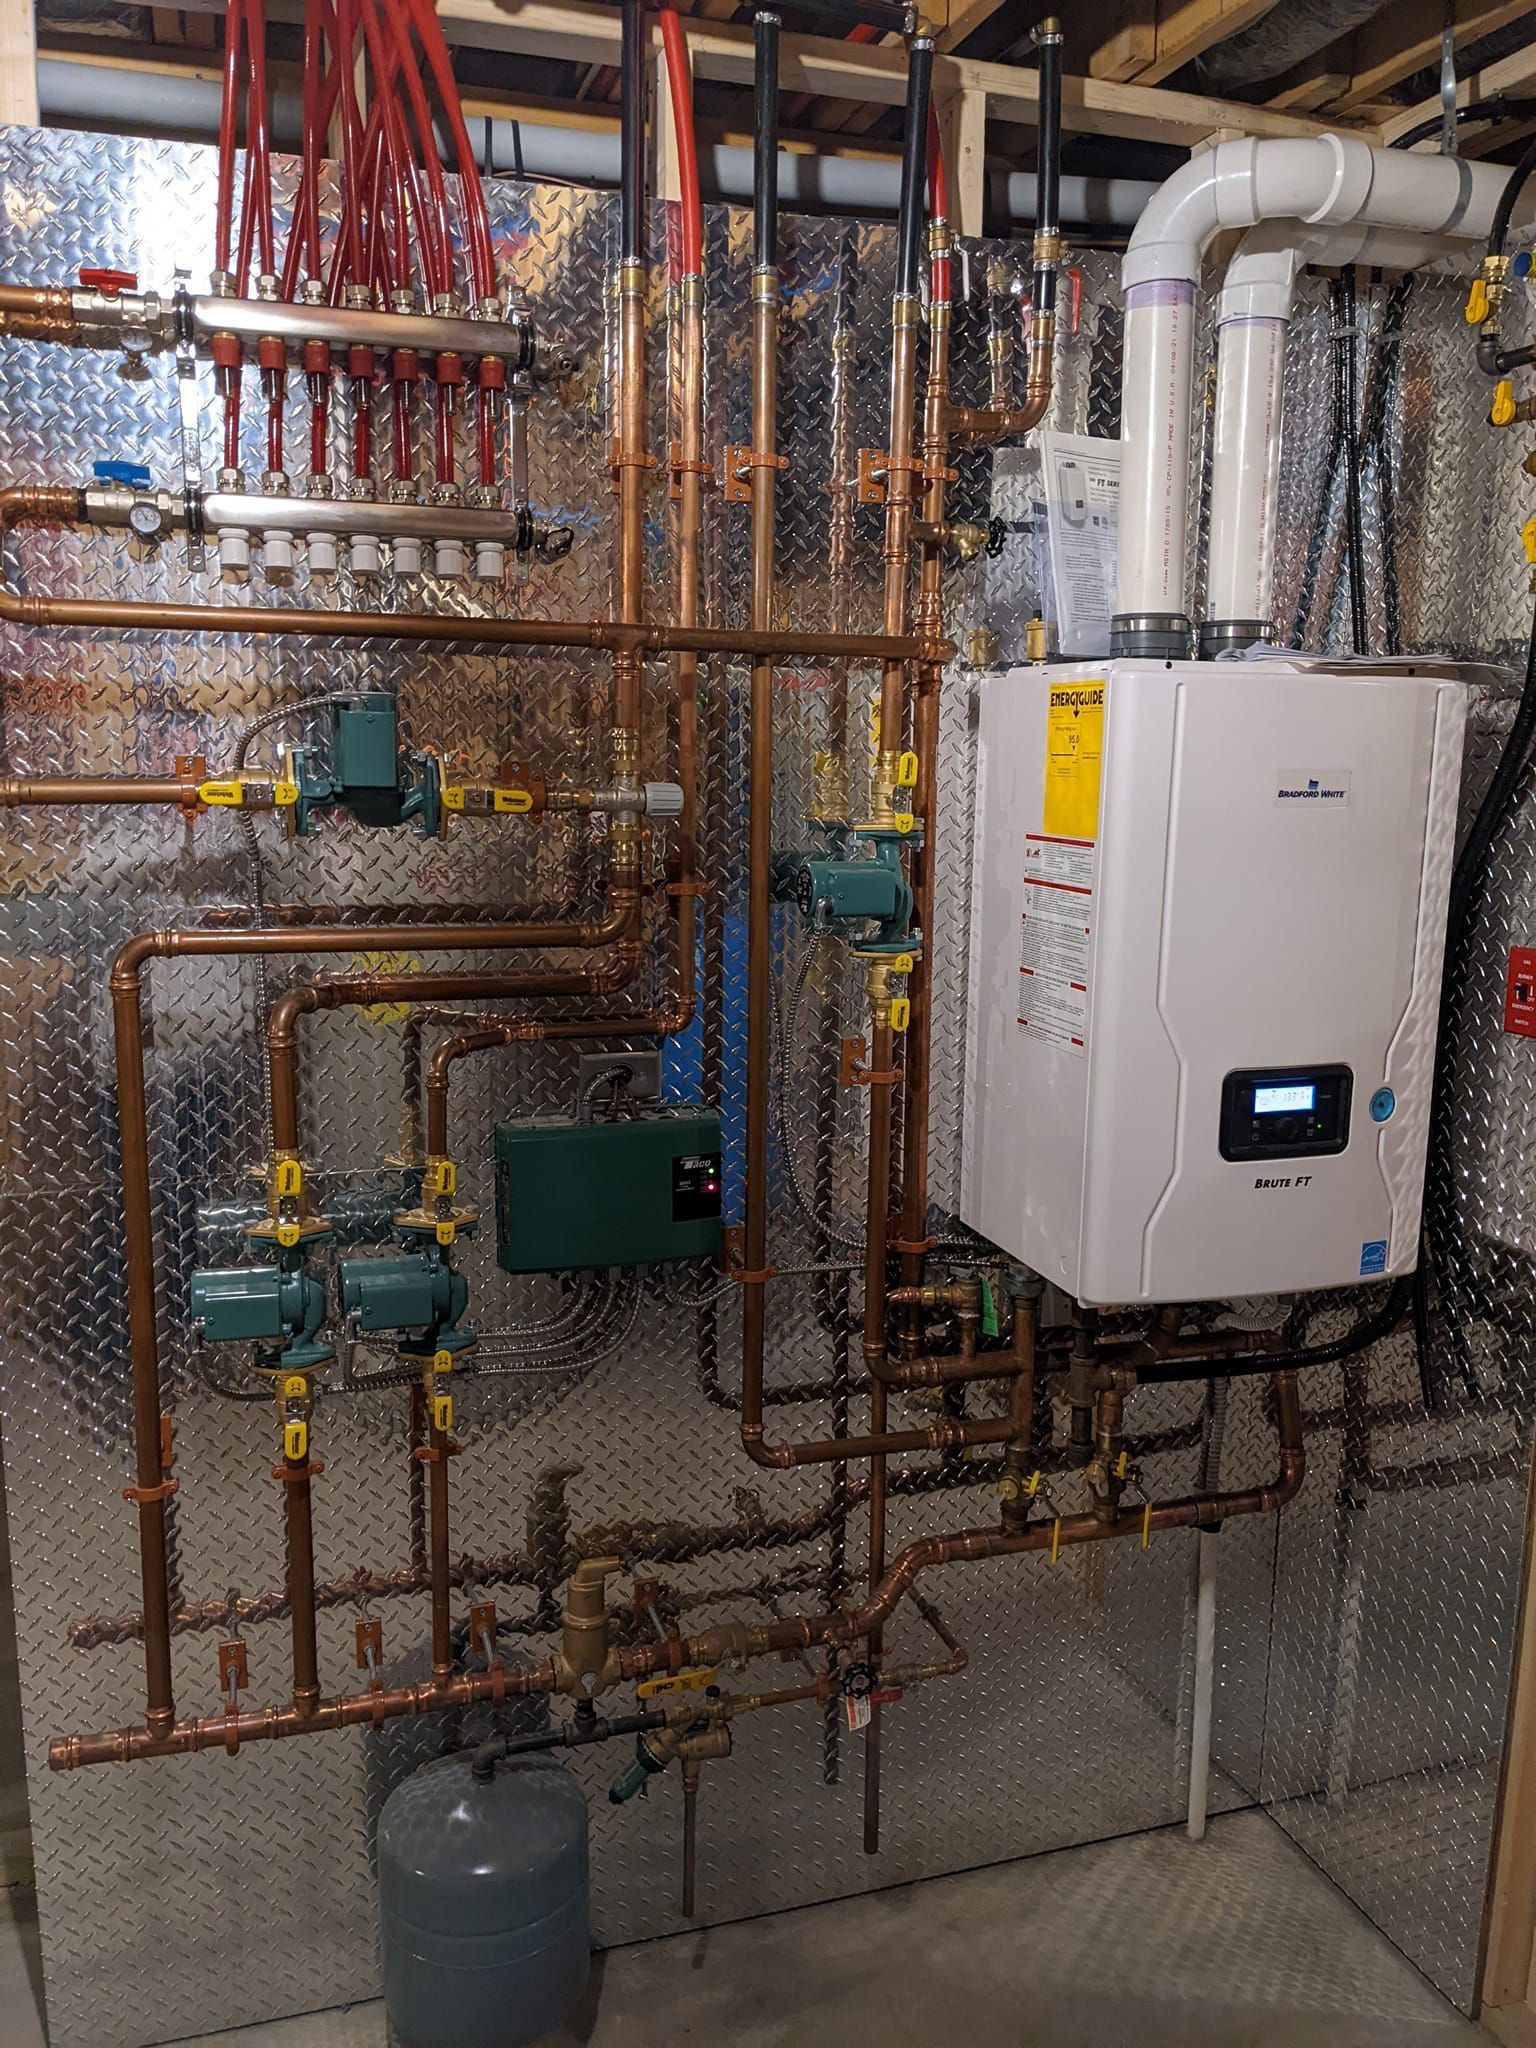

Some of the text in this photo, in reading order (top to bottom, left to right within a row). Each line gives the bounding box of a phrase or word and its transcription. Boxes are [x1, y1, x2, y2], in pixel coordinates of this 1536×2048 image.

[1050, 689, 1104, 707] ENERGYGUIDE
[1278, 789, 1345, 798] BRADFORD WHITE
[1254, 1176, 1312, 1189] BRUTE FT
